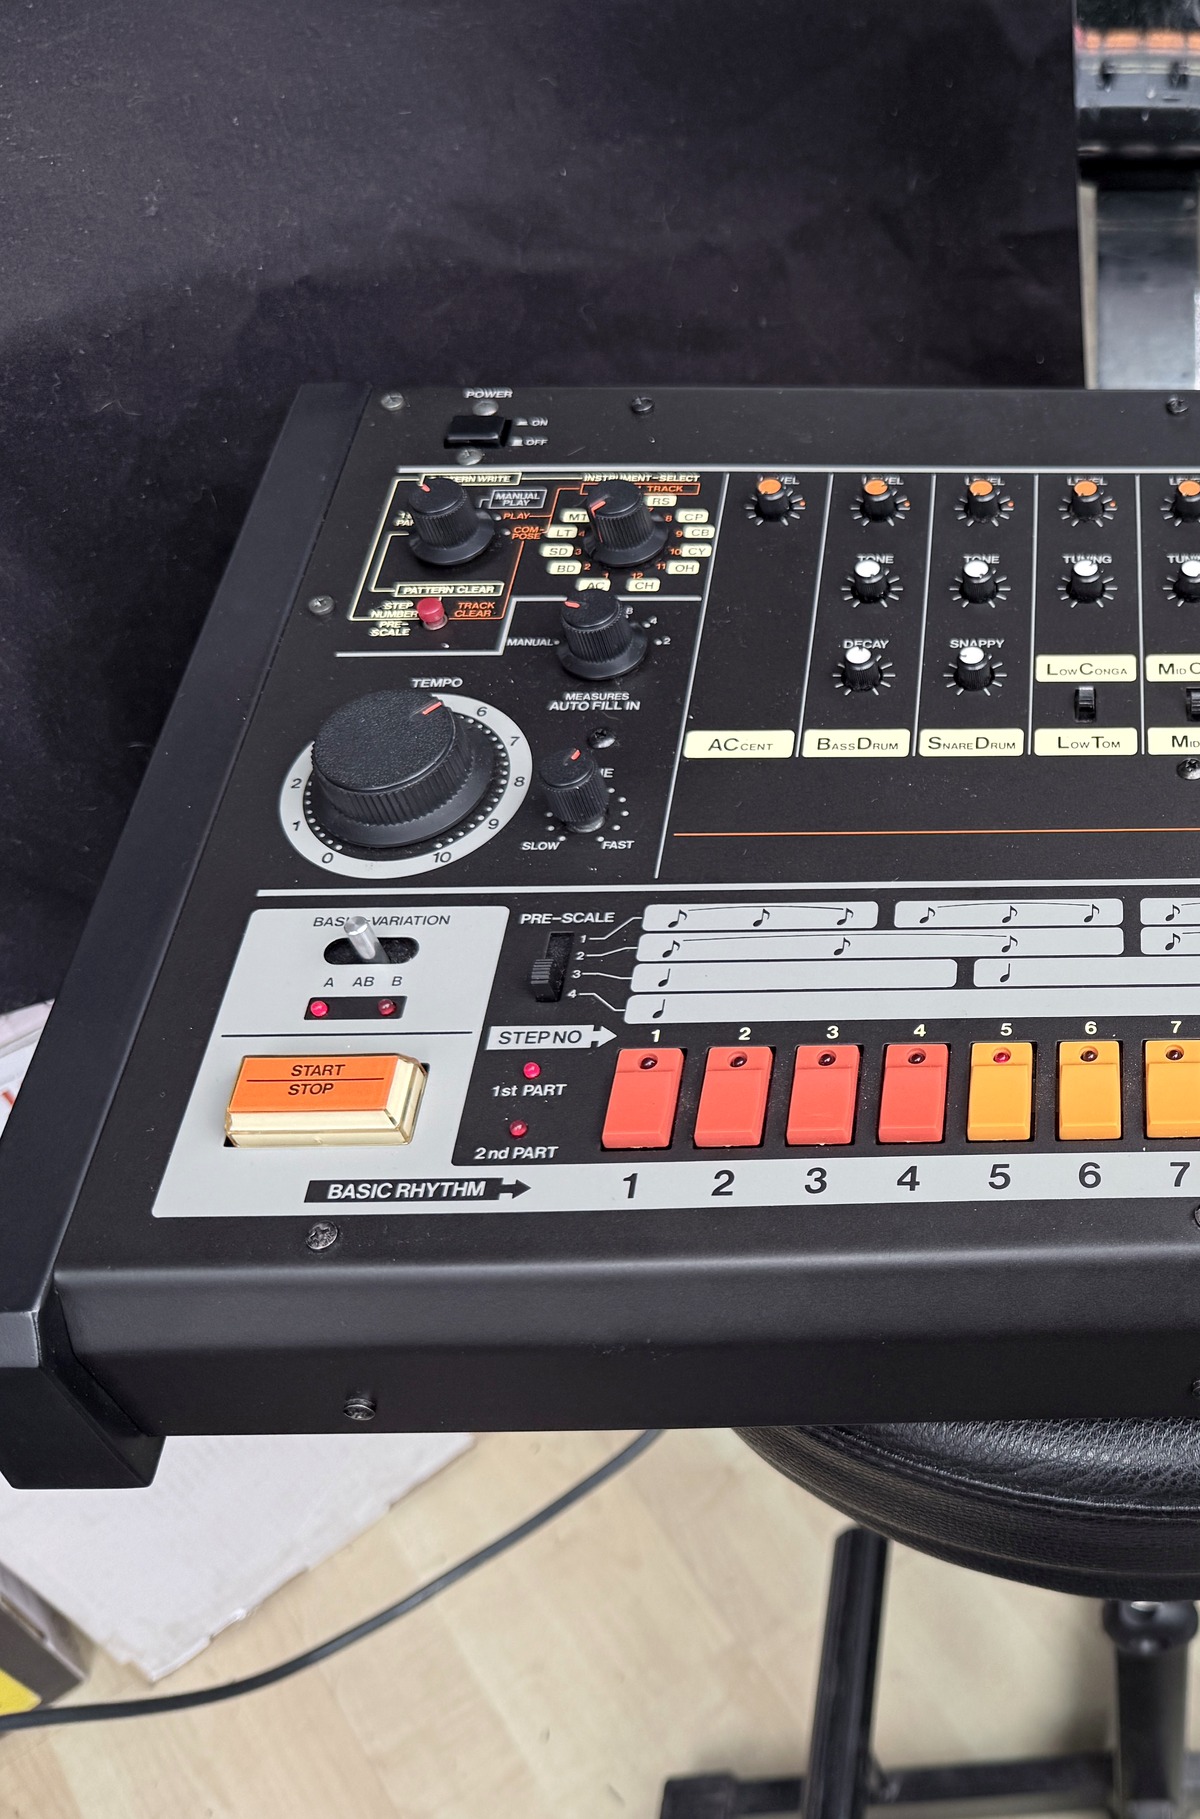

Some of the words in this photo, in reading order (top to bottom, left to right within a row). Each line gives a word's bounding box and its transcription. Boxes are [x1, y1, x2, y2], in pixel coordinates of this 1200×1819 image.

[464, 389, 513, 399] POWER
[531, 418, 548, 427] ON
[525, 438, 548, 446] OFF
[477, 475, 511, 483] WRITE
[495, 492, 540, 500] MANUAL
[503, 512, 530, 520] PLAY
[684, 513, 704, 521] CP
[556, 529, 573, 537] LT
[691, 528, 710, 536] CB
[549, 547, 568, 556] SD
[688, 547, 706, 556] CY
[557, 564, 576, 573] BD
[675, 564, 695, 572] OH
[403, 586, 454, 594] PATTERN
[587, 581, 605, 589] AC
[635, 581, 654, 590] CH
[369, 610, 419, 618] NUMBER
[454, 610, 492, 618] CLEAR
[379, 620, 409, 628] PRE-
[369, 628, 411, 636] SCALE
[506, 638, 553, 646] MANUAL
[412, 678, 463, 688] TEMPO
[564, 692, 630, 700] MEASURES
[549, 701, 590, 711] AUTO
[592, 701, 622, 710] FILL
[625, 701, 640, 710] IN
[476, 706, 488, 717] 6
[510, 736, 520, 746] 7
[290, 778, 302, 789] 2
[513, 776, 525, 787] 8
[292, 821, 300, 831] 1
[488, 819, 499, 830] 9
[521, 841, 560, 851] SLOW
[601, 840, 635, 849] FAST
[321, 853, 334, 864] 0
[433, 852, 452, 863] 10
[520, 911, 615, 924] PRE-SCALE
[576, 951, 585, 960] 2
[572, 970, 582, 979] 3
[323, 977, 334, 988] A
[352, 976, 375, 987] AB
[391, 976, 403, 986] B
[567, 989, 577, 998] 4
[913, 1023, 926, 1037] 4
[1000, 1022, 1013, 1037] 5
[1085, 1020, 1098, 1035] 6
[1170, 1020, 1182, 1034] 7
[498, 1031, 551, 1045] STEP
[552, 1030, 582, 1044] NO
[650, 1030, 661, 1042] 1
[739, 1027, 752, 1041] 2
[826, 1025, 839, 1040] 3
[291, 1064, 346, 1078] START
[287, 1083, 334, 1096] STOP
[492, 1085, 518, 1096] 1st
[522, 1084, 567, 1096] PART
[474, 1147, 510, 1160] 2nd
[512, 1146, 558, 1159] PART
[896, 1165, 921, 1192] 4
[988, 1163, 1011, 1190] 5
[1078, 1162, 1102, 1189] 6
[1169, 1161, 1191, 1188] 7
[622, 1173, 638, 1199] 1
[711, 1170, 735, 1197] 2
[804, 1168, 827, 1195] 3
[327, 1182, 393, 1199] BASIC
[398, 1181, 486, 1198] RHYTHM
